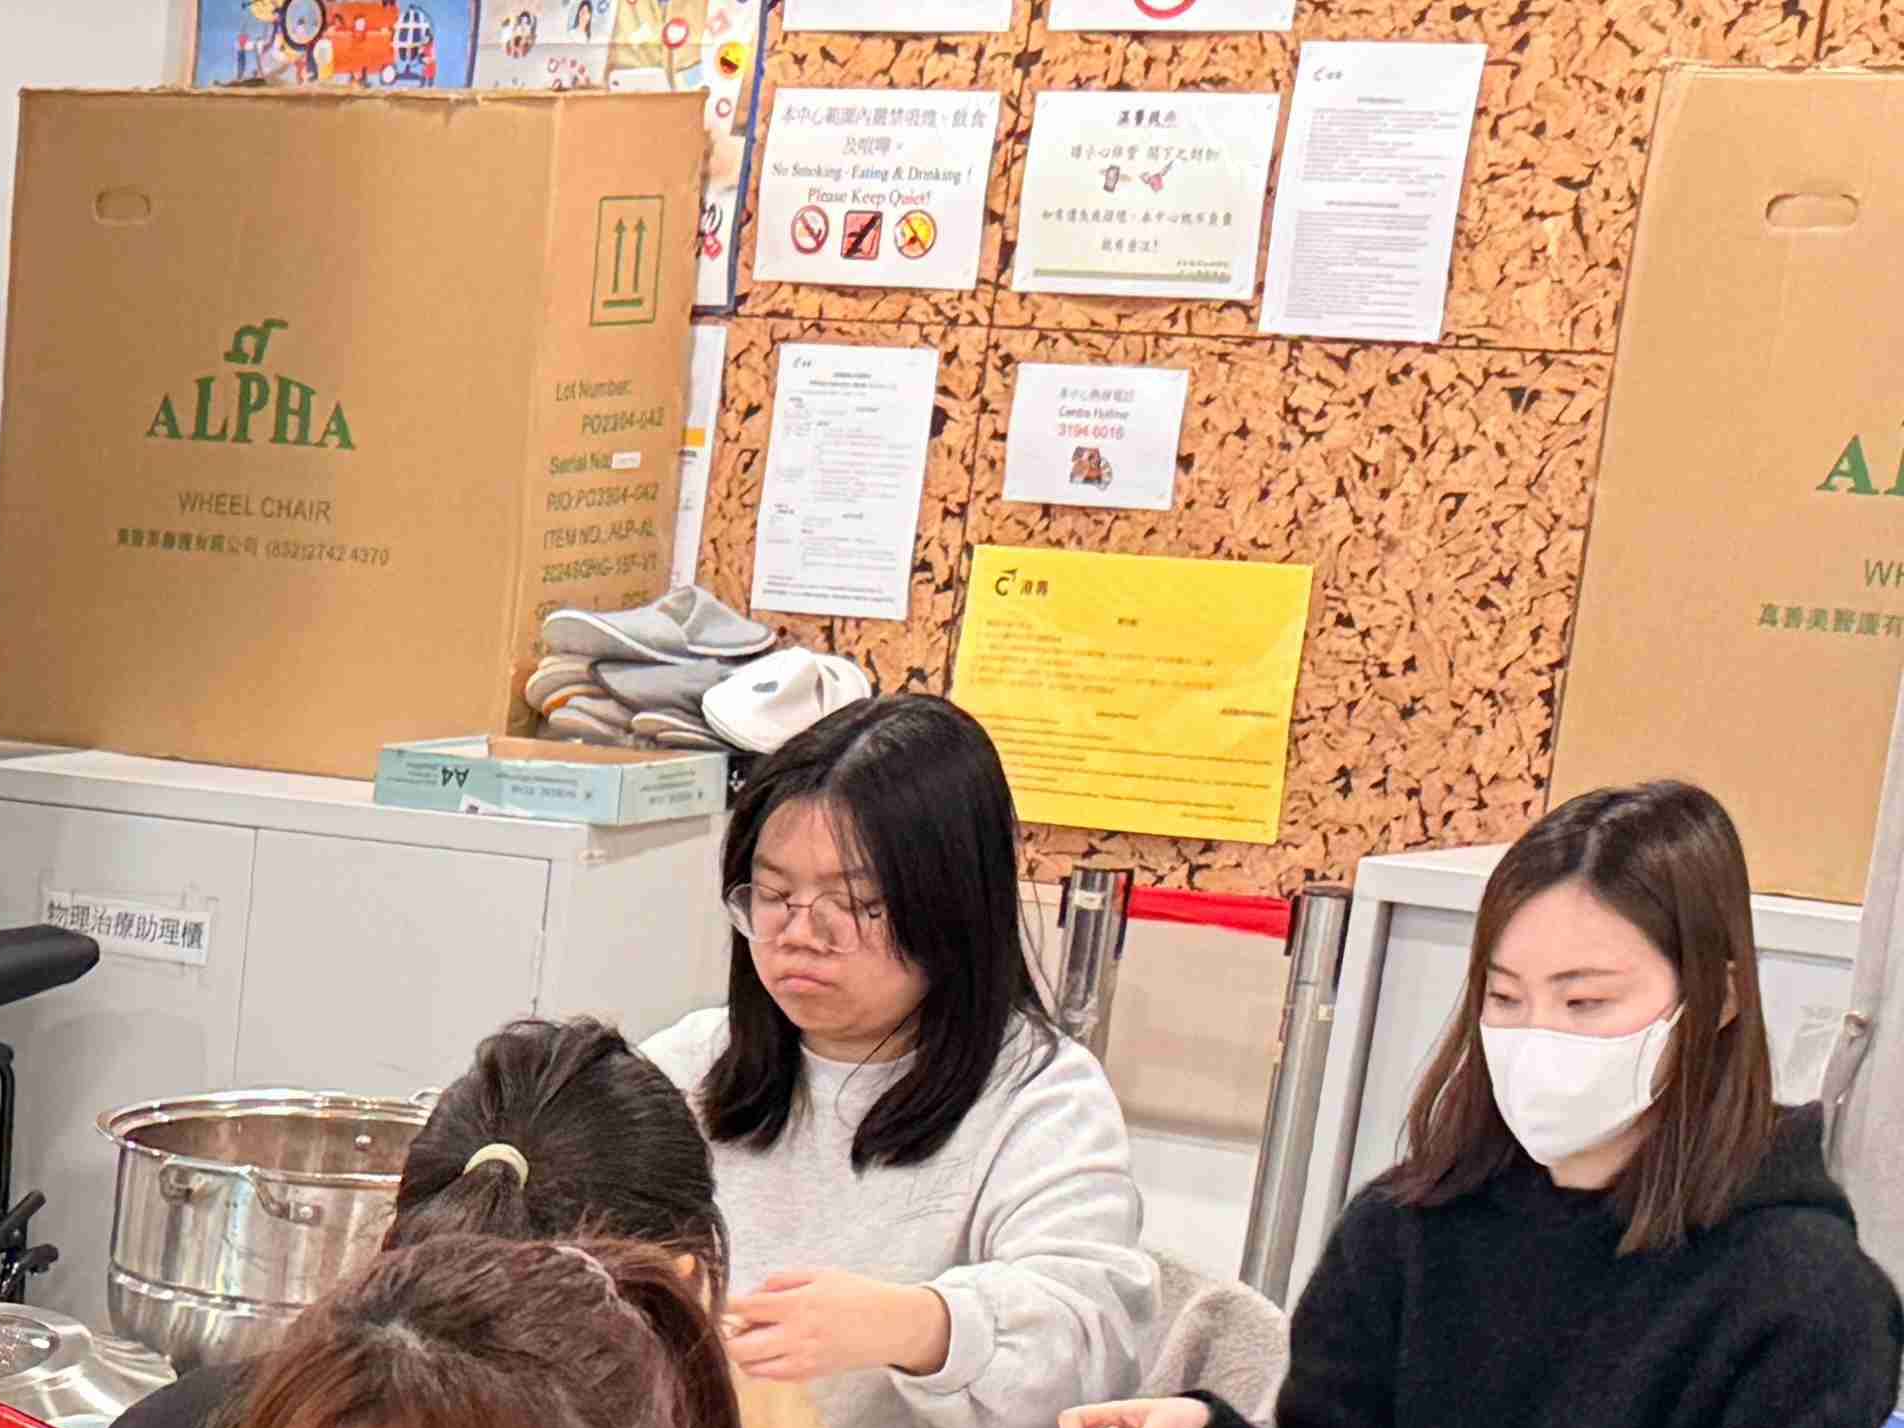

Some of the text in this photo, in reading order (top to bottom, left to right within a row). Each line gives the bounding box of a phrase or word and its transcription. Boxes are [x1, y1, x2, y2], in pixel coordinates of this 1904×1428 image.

[145, 371, 356, 450] ALPHA
[178, 491, 332, 522] WHEEL CHAIR
[441, 767, 470, 788] A4
